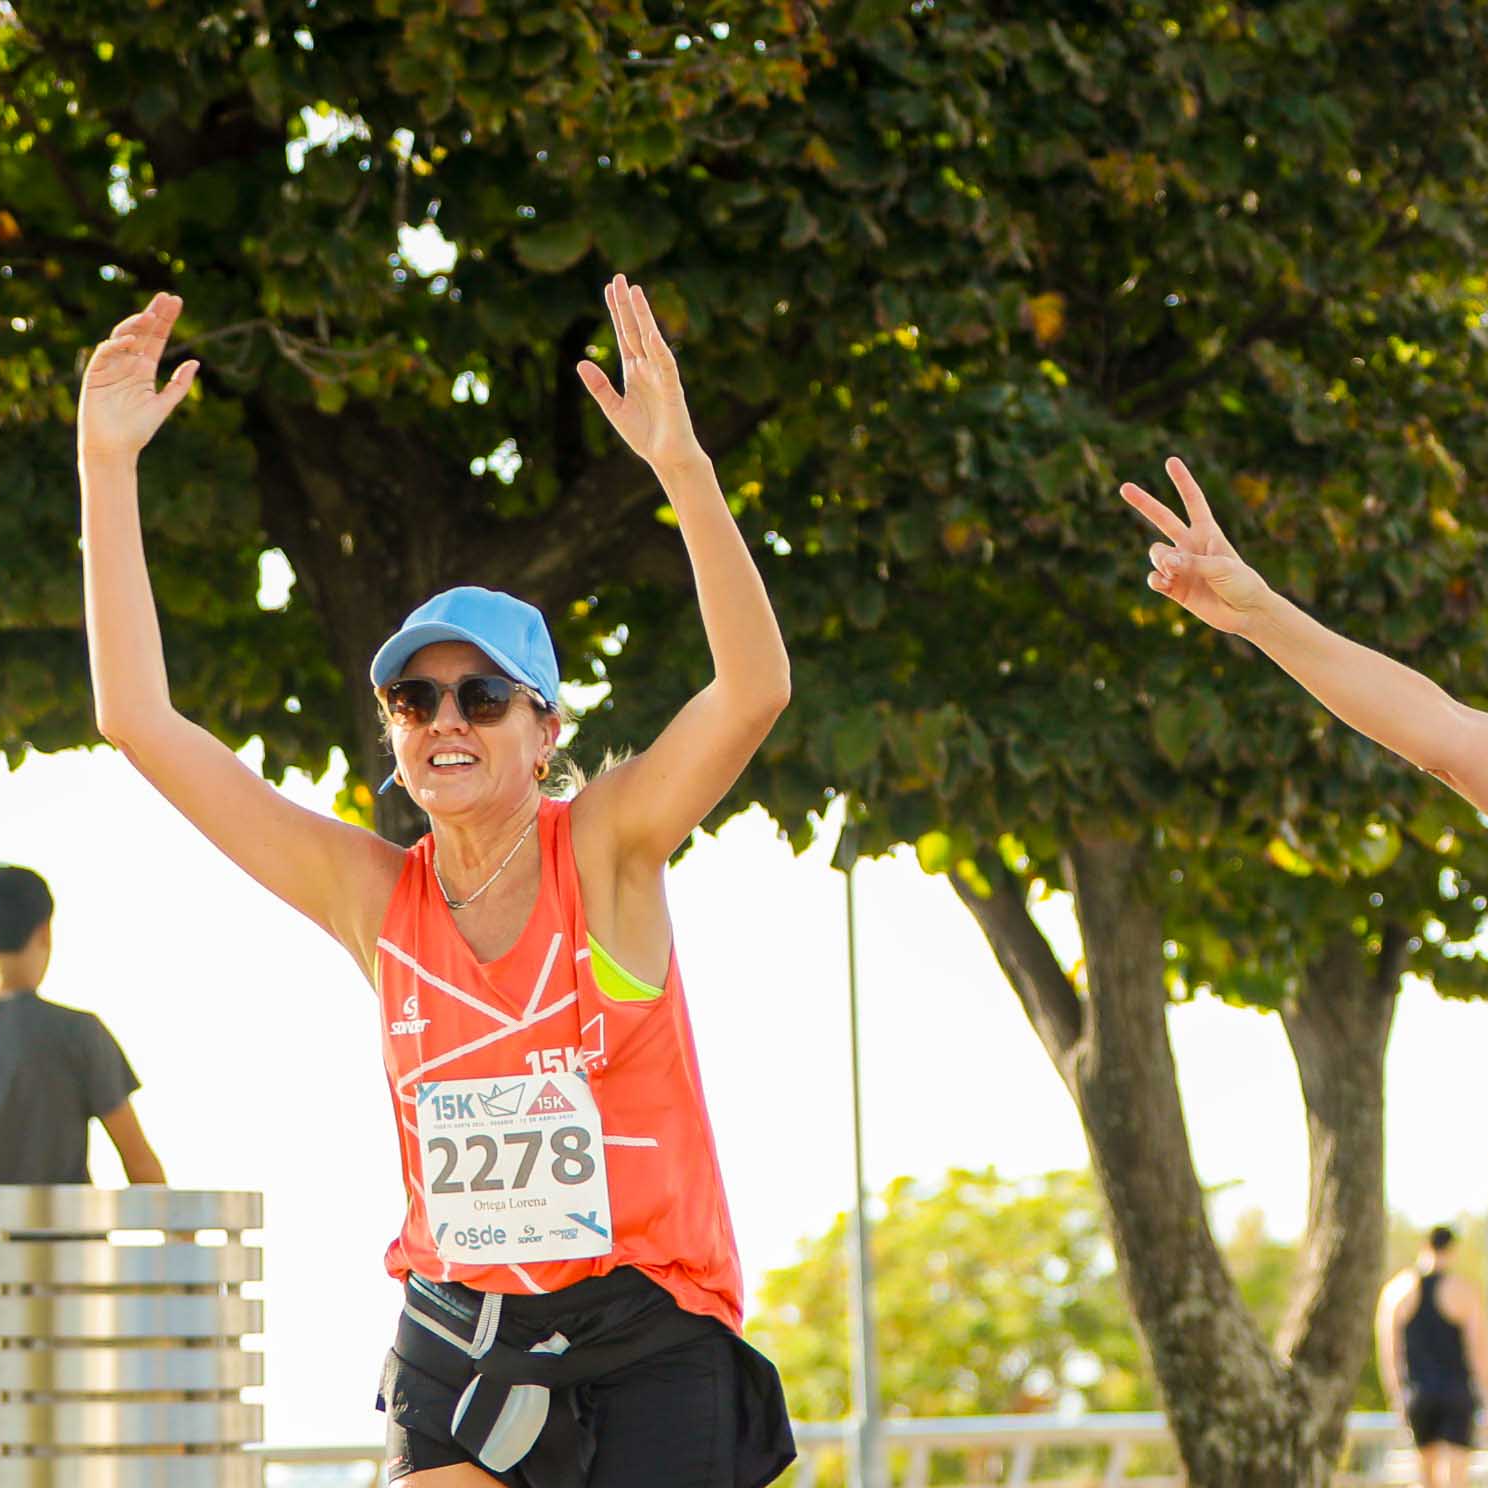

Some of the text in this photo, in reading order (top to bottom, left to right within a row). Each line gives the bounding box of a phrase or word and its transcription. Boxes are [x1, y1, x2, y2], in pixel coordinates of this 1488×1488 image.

[525, 1047, 584, 1074] 15K
[432, 1093, 476, 1121] 15K
[538, 1095, 565, 1110] 15K
[427, 1126, 596, 1194] 2278
[474, 1198, 547, 1211] Ortega Lorena
[454, 1224, 507, 1250] osde
